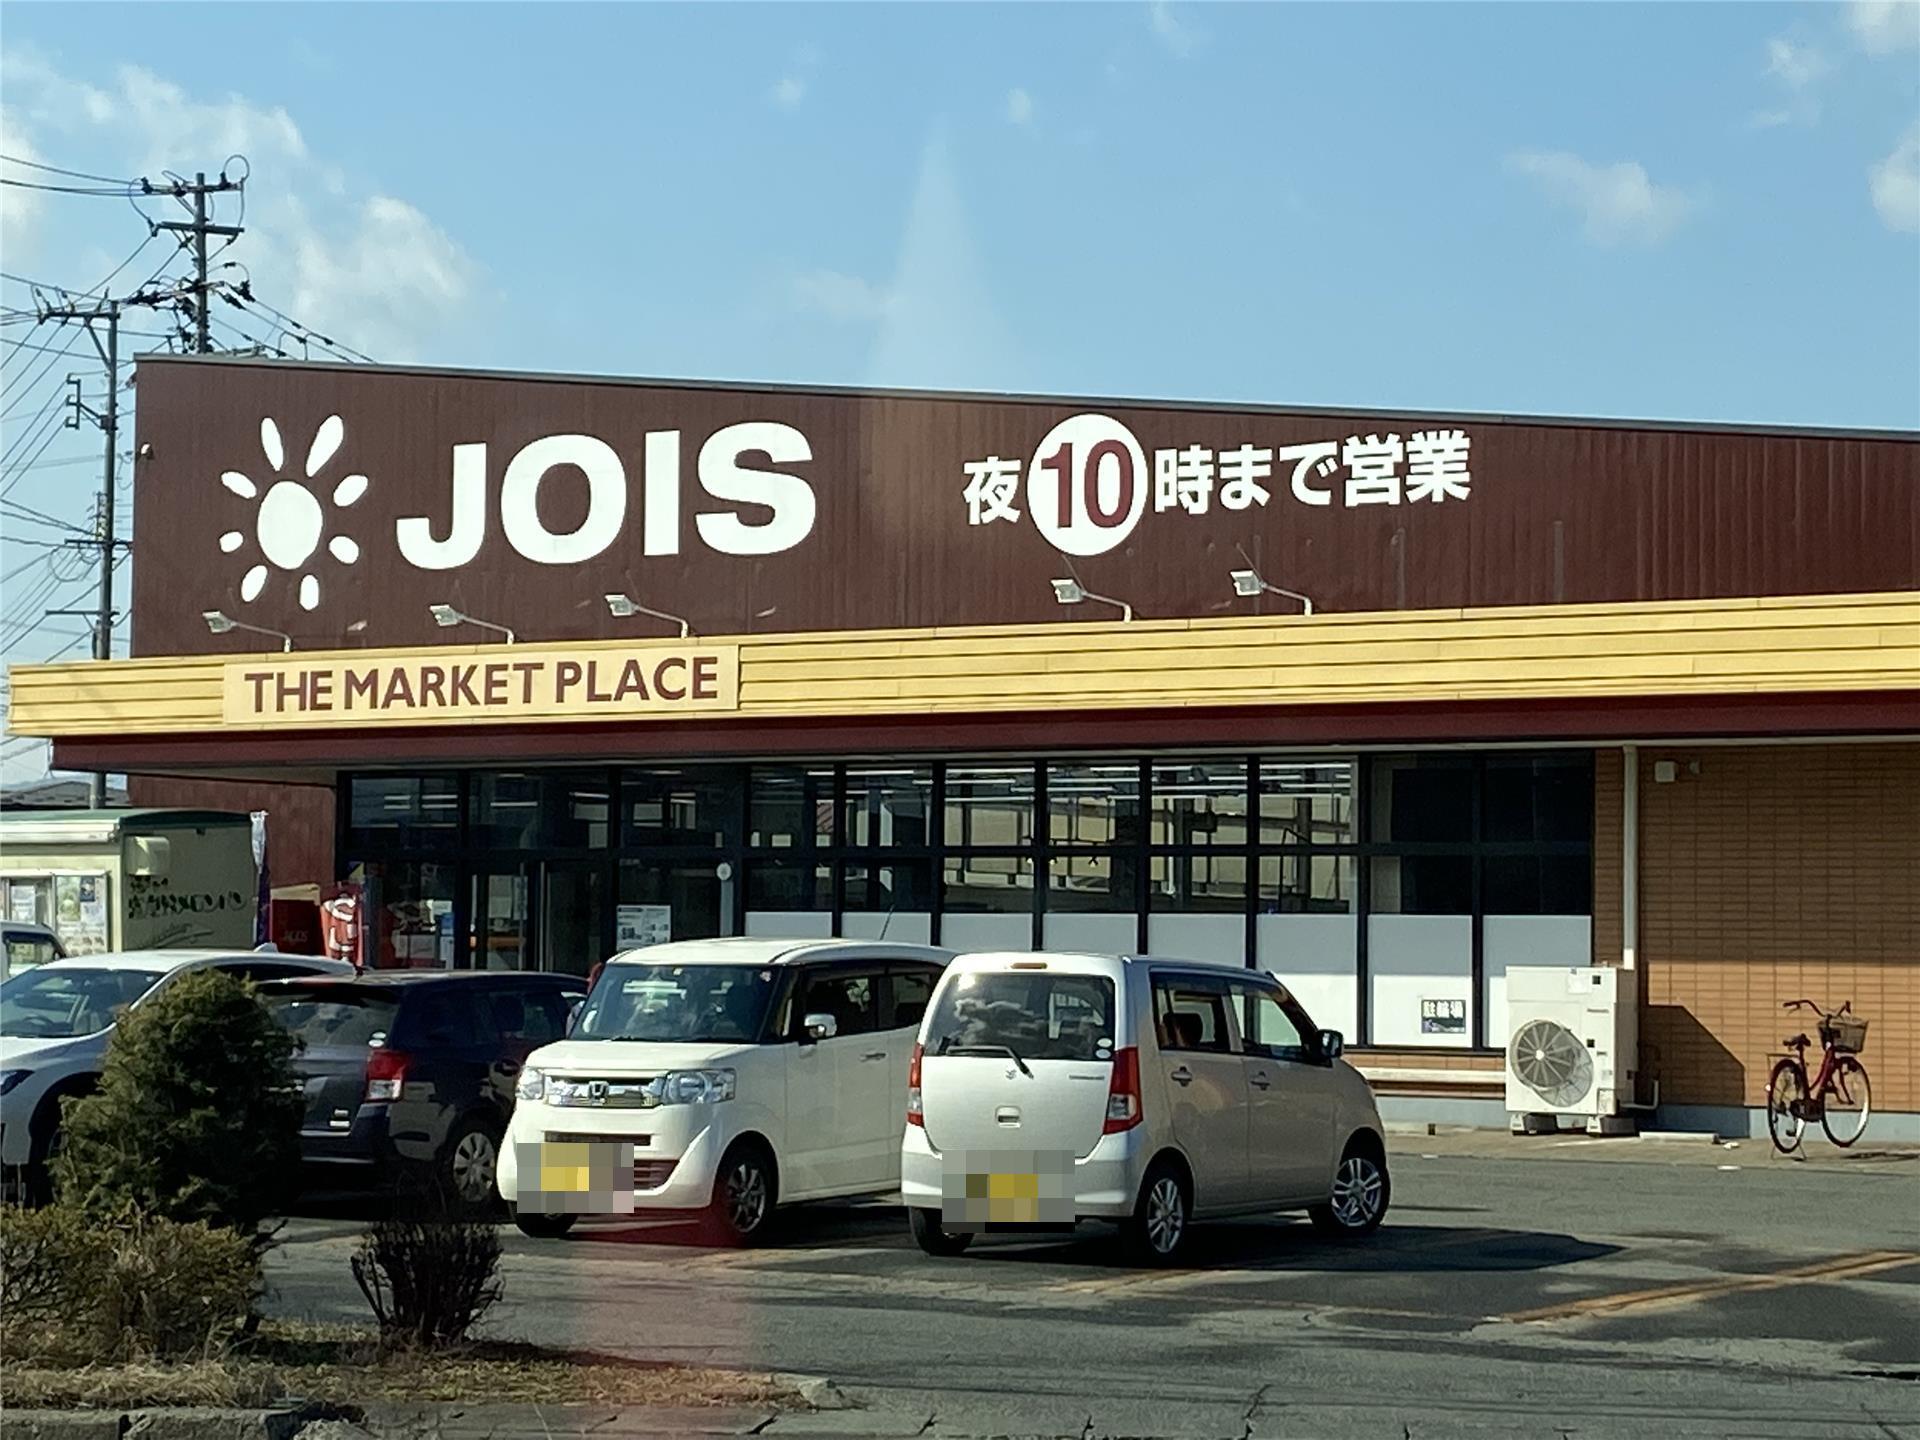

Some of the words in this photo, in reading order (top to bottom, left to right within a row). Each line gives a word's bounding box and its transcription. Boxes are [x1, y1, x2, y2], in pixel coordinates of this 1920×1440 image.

[396, 421, 816, 569] JOIS
[245, 670, 333, 713] THE
[344, 662, 545, 711] MARKET
[556, 656, 719, 704] PLACE
